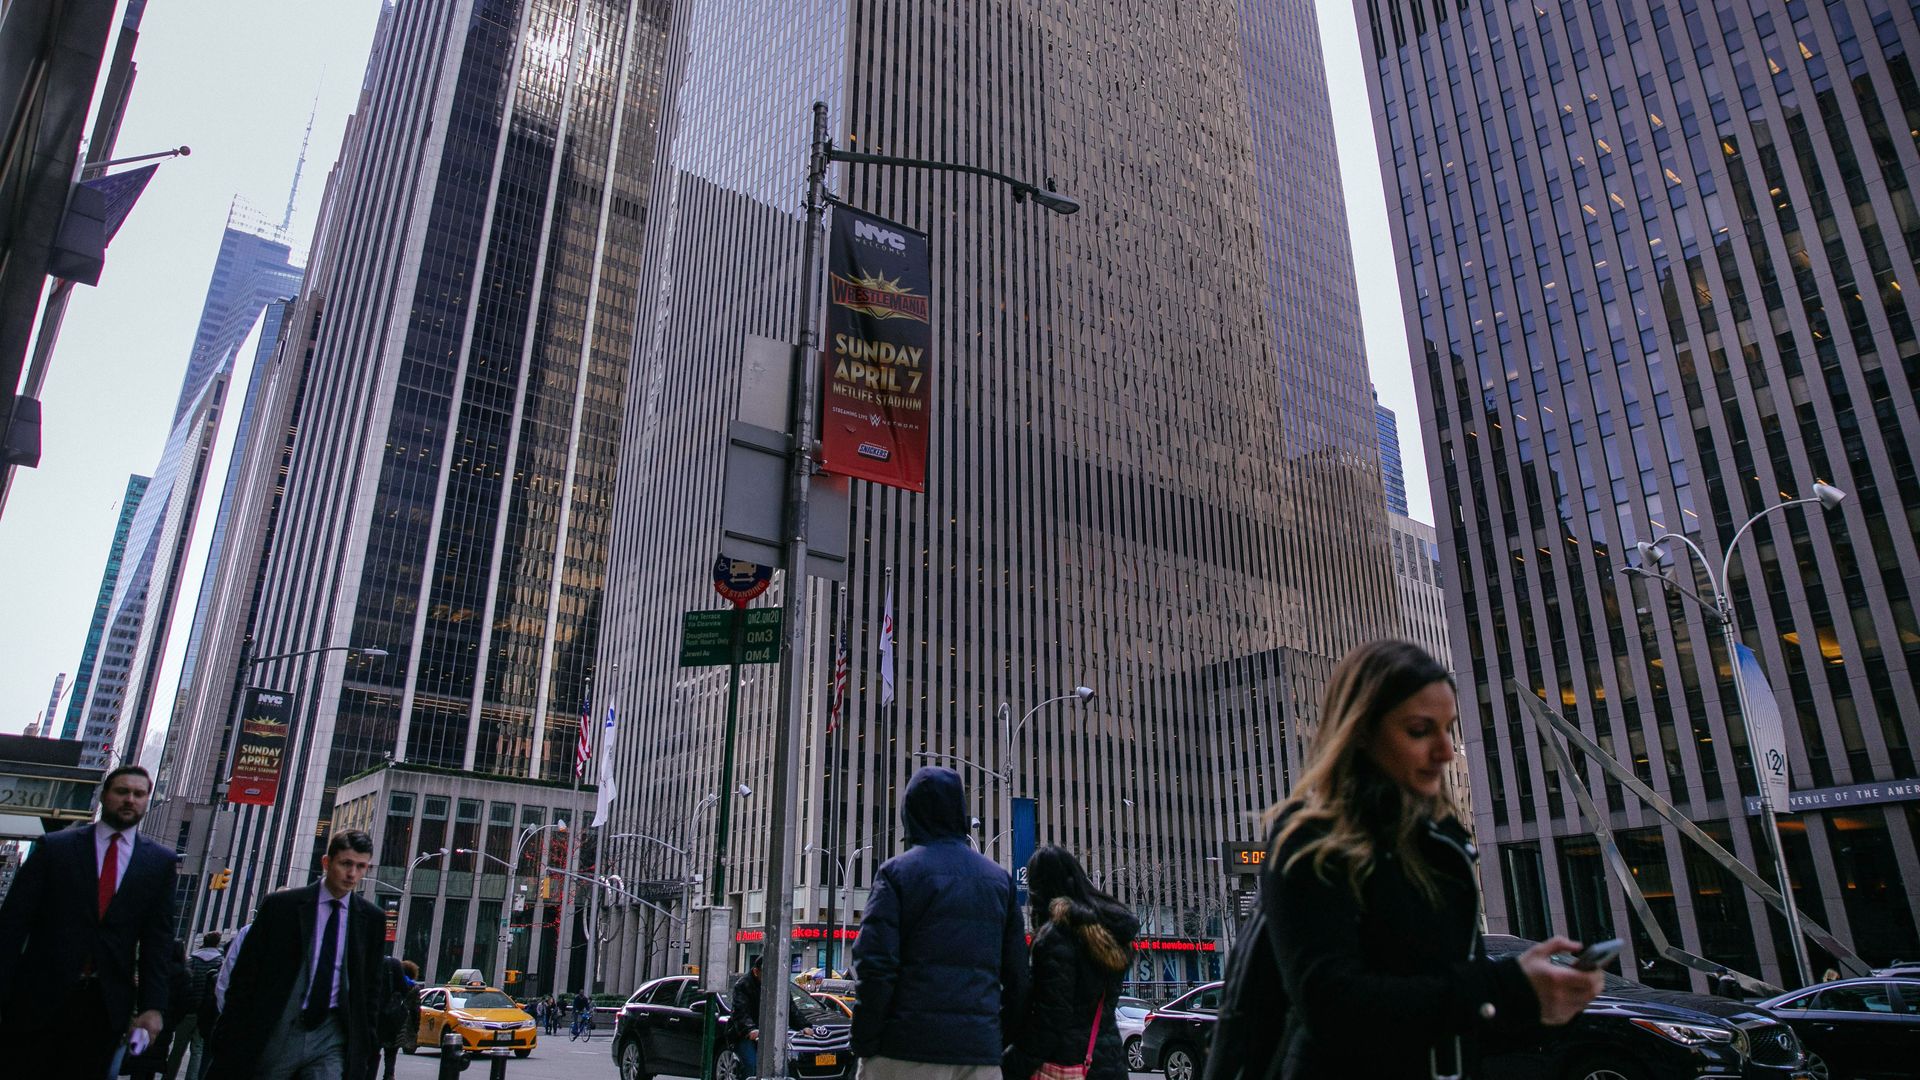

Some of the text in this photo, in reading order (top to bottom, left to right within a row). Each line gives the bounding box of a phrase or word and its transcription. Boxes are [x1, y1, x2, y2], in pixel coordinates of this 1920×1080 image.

[855, 220, 906, 251] NYC
[856, 239, 906, 257] WELCOMES
[835, 333, 923, 368] SUNDAY
[834, 358, 922, 393] APRIL 7
[833, 382, 922, 411] METLIFE STADIUM
[832, 406, 858, 418] STREAMING
[882, 420, 919, 430] NETWORK
[860, 444, 887, 458] SNICKERS
[730, 581, 767, 598] STANDING
[747, 629, 773, 644] QM3
[745, 647, 770, 661] QM4
[258, 693, 284, 705] NYC
[242, 744, 282, 757] SUNDAY
[240, 755, 280, 767] APRIL 7
[1790, 794, 1827, 806] VENUE
[1836, 791, 1849, 801] OF
[1856, 788, 1880, 800] THE
[791, 927, 820, 939] akes
[1161, 941, 1195, 951] newborn
